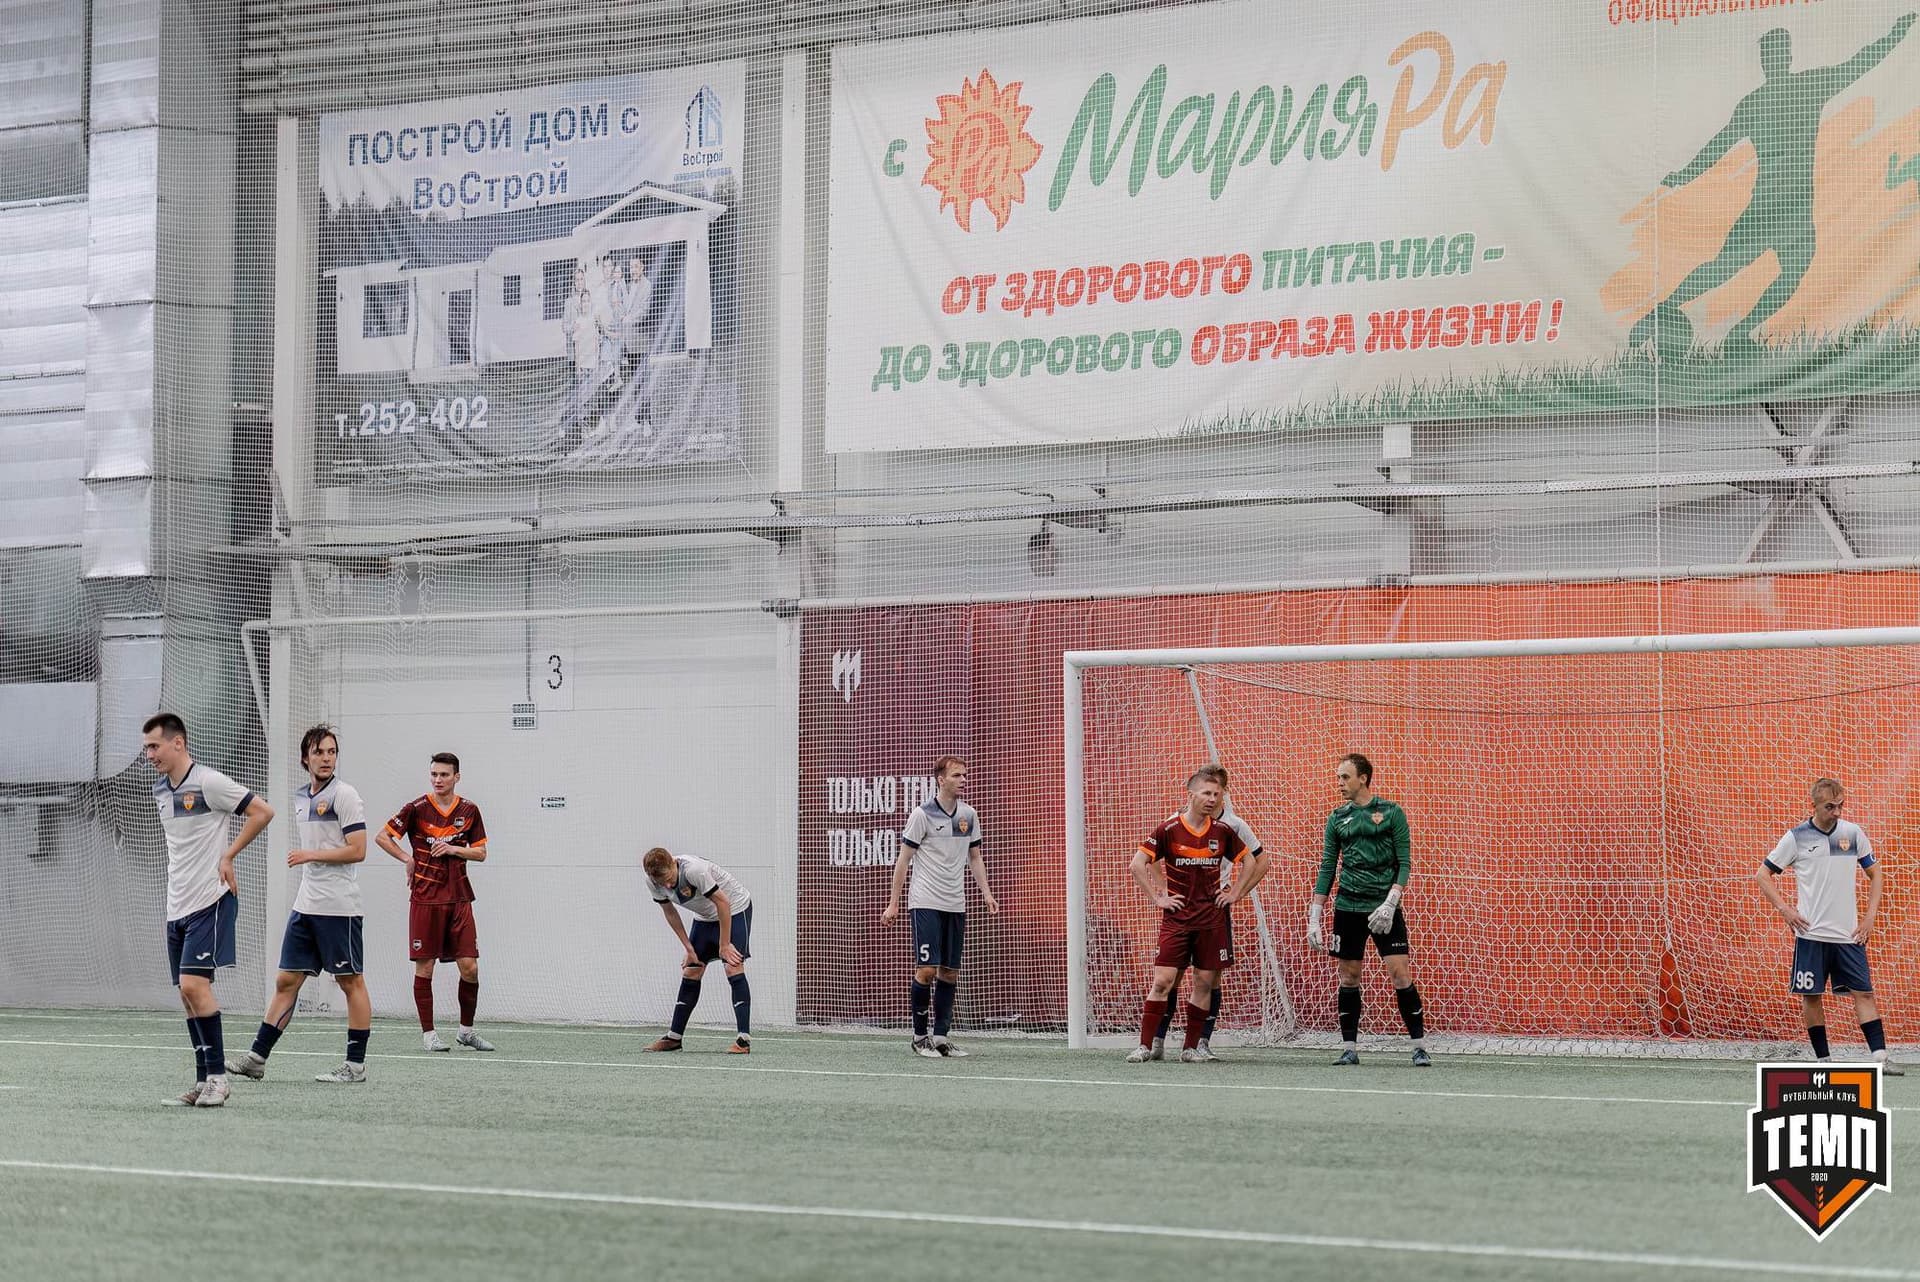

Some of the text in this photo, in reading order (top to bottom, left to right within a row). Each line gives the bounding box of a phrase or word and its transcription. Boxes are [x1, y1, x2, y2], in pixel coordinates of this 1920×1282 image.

[349, 108, 512, 166] ПОСТРОЙ
[524, 103, 608, 153] ДОМ
[413, 160, 569, 210] ВоСтрой
[941, 273, 997, 315] ОТ
[1001, 253, 1252, 318] ЗДОРОВОГО
[1262, 232, 1476, 291] ПИТАНИЯ
[871, 343, 932, 392] ДО
[937, 328, 1183, 388] ЗДОРОВОГО
[1191, 313, 1356, 366] ОБРАЗА
[548, 654, 563, 690] 3
[827, 776, 896, 814] ТОЛЬКО
[828, 829, 896, 866] ТОЛЬКО
[920, 943, 930, 962] 5
[1796, 970, 1815, 990] 96
